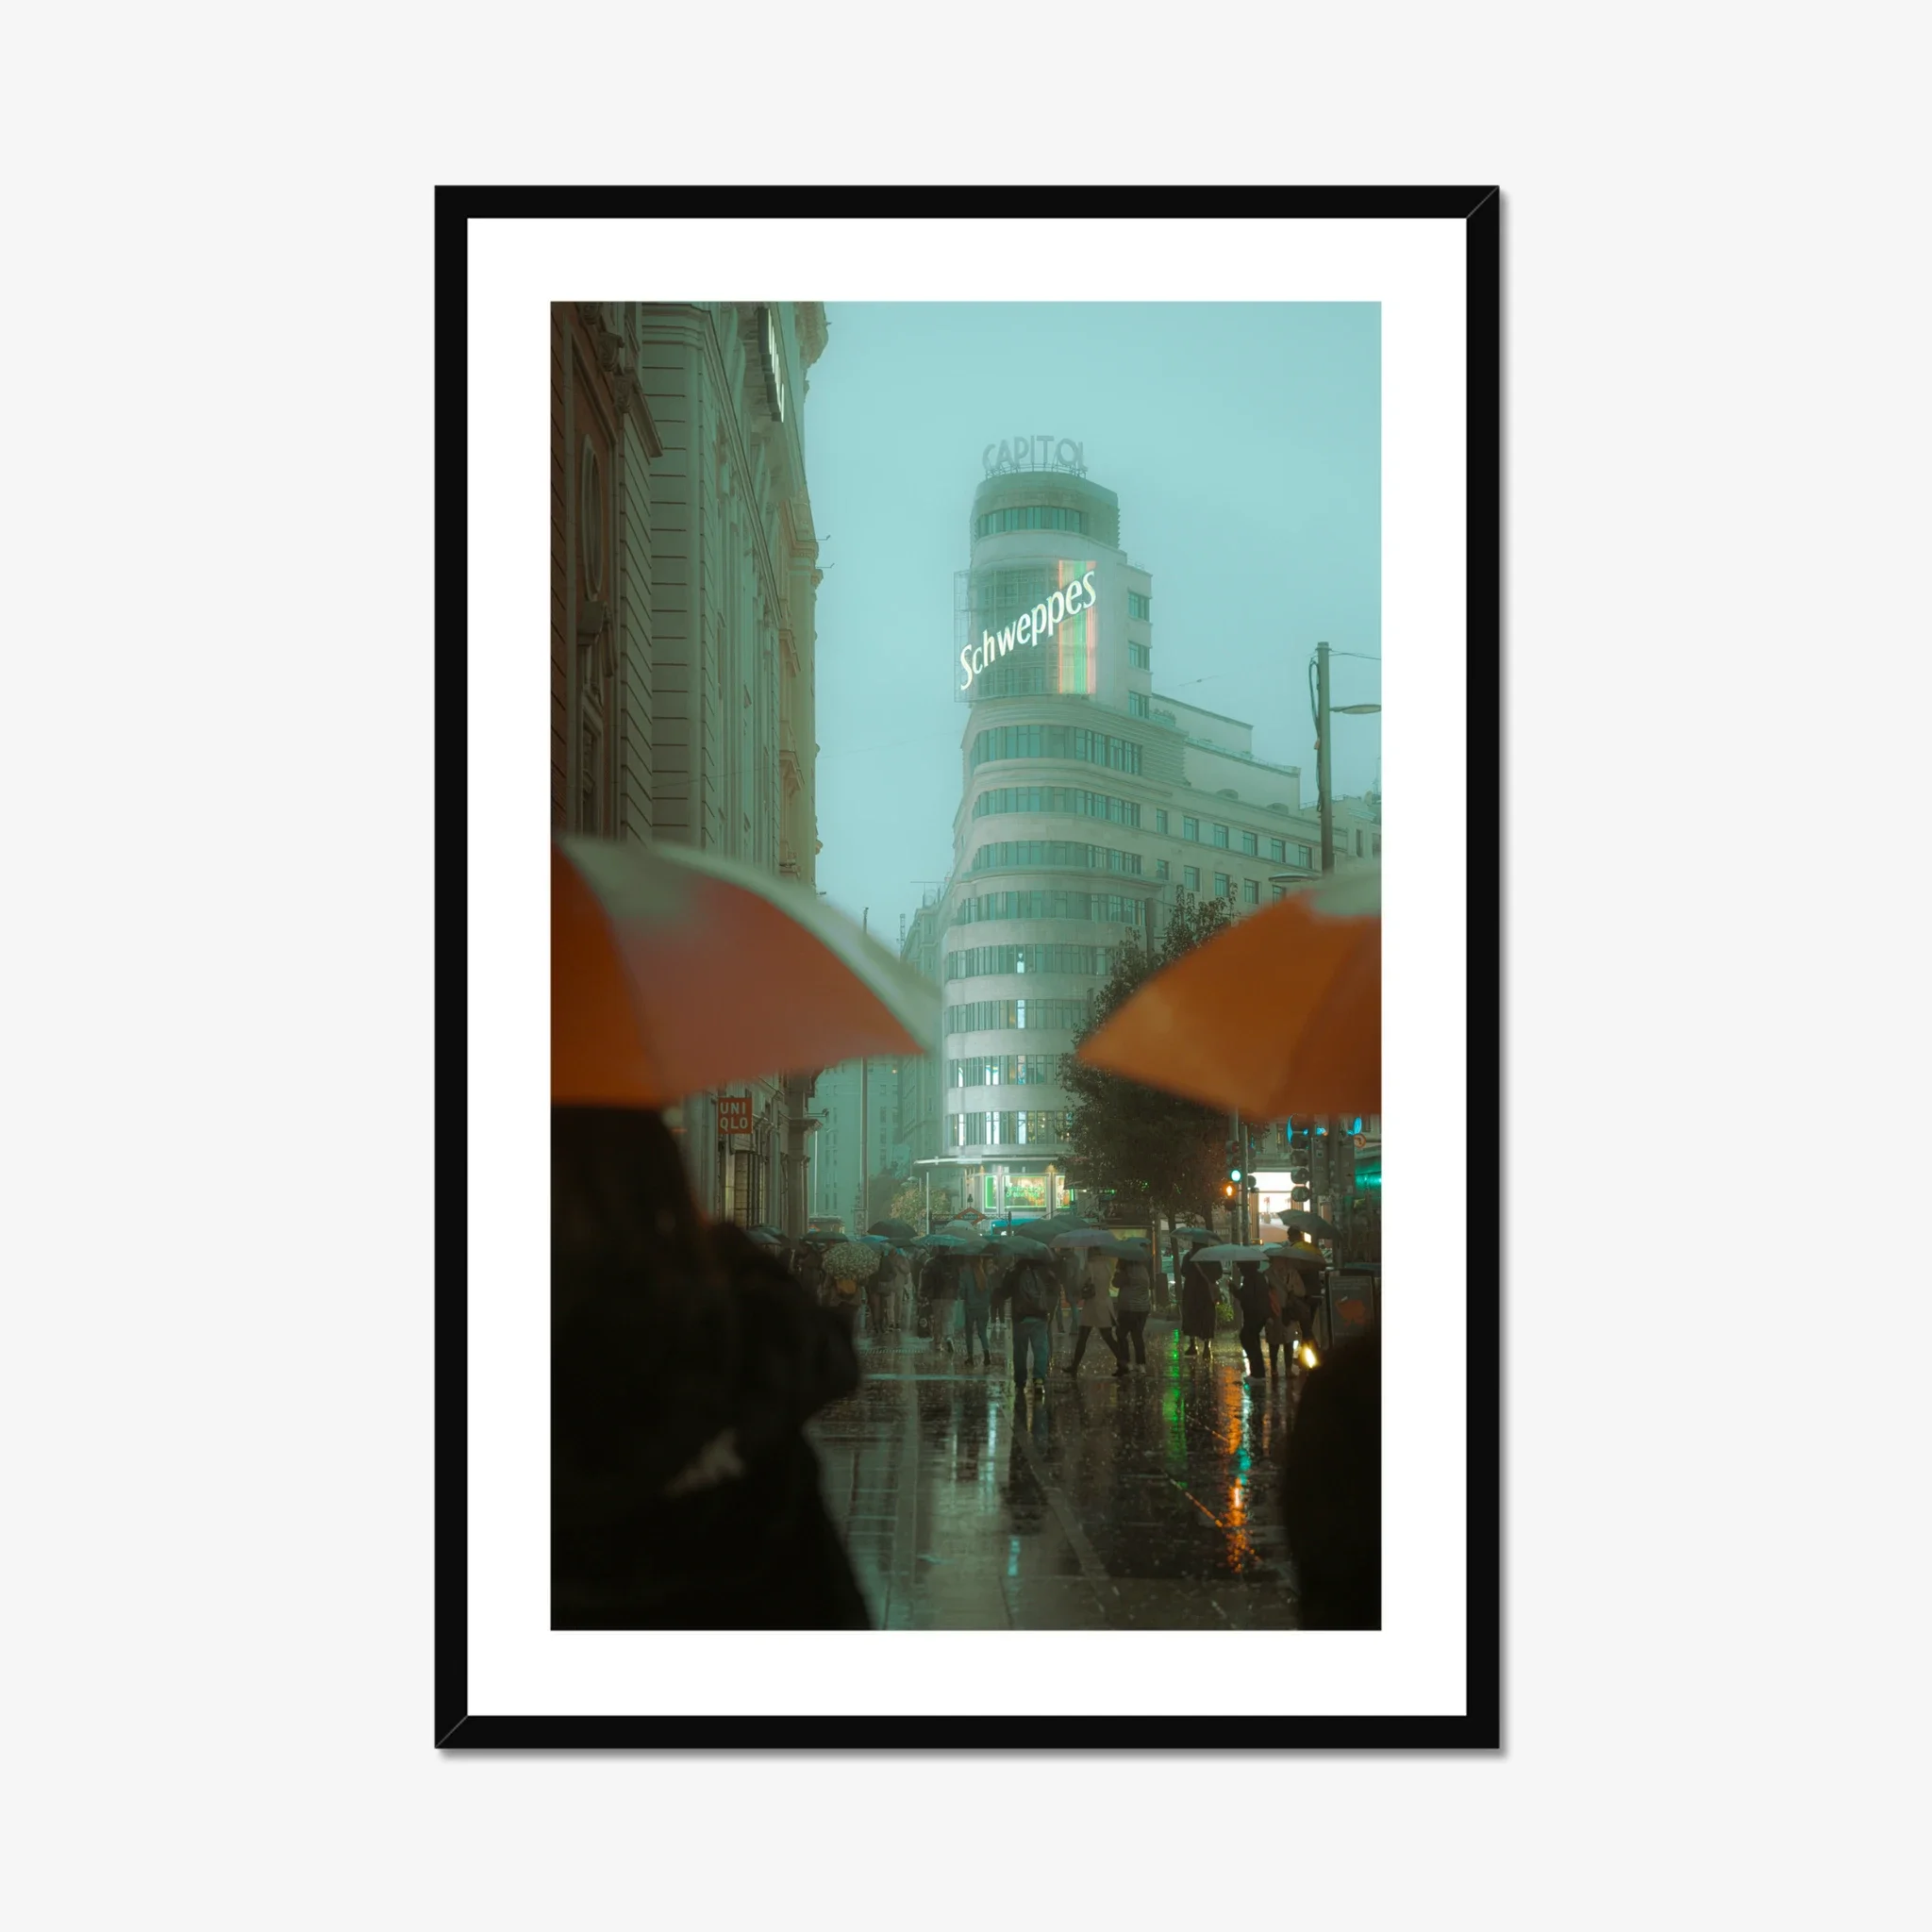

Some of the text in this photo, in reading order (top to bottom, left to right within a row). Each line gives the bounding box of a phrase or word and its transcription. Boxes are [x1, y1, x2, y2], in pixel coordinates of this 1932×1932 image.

[982, 435, 1089, 472] CAPITOL
[960, 570, 1096, 691] Schweppes
[720, 1102, 746, 1114] UNI
[720, 1117, 748, 1132] QLO
